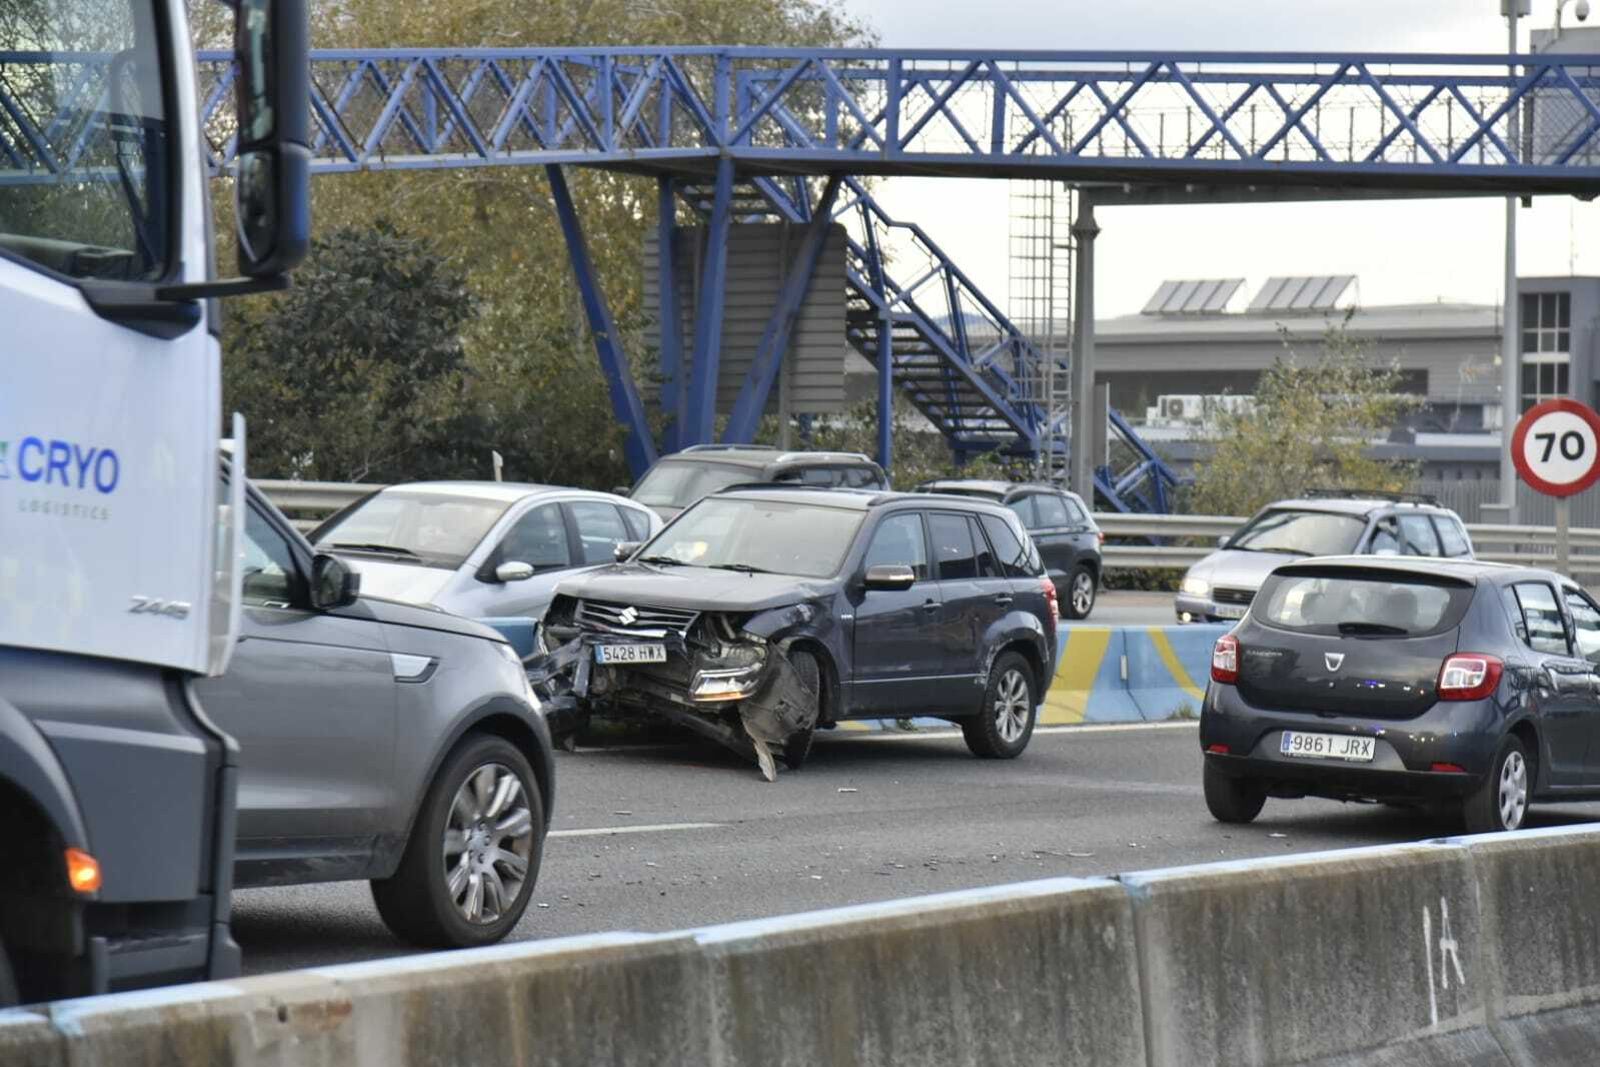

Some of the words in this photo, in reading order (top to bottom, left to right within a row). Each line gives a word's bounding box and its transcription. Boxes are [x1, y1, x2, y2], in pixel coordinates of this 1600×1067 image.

[1534, 430, 1585, 463] 70
[17, 436, 120, 494] CRYO
[603, 646, 636, 661] 5428
[1293, 735, 1333, 754] 9861
[1340, 738, 1371, 756] JRX
